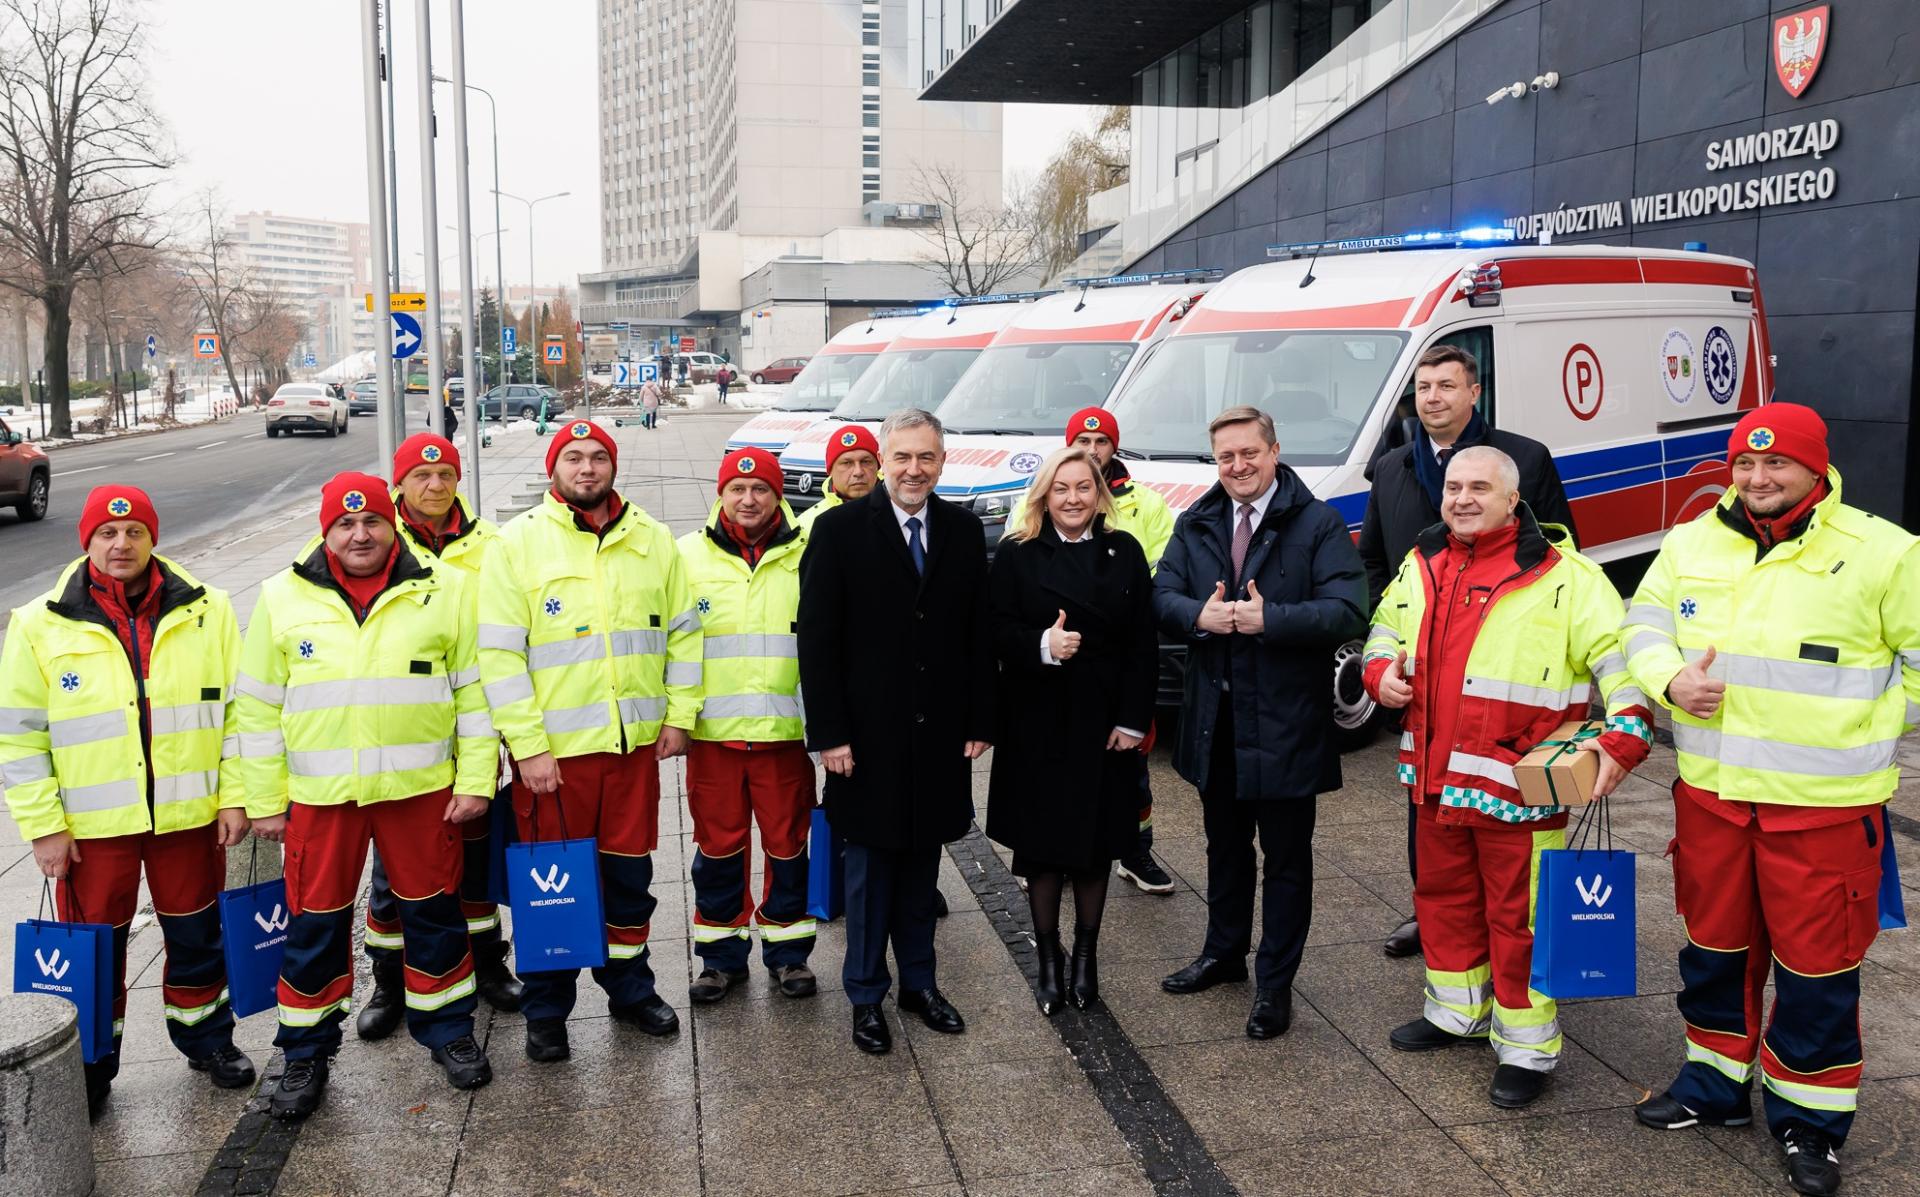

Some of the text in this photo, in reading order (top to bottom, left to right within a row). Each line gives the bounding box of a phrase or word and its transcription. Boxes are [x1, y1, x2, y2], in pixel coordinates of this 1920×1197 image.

[1706, 119, 1839, 171] SAMORZĄD
[1631, 167, 1836, 225] WIELKOPOLSKIEGO
[1341, 237, 1400, 249] AMBULANS
[1576, 361, 1592, 404] P
[530, 897, 575, 907] WIELKOPOLSKA
[1571, 913, 1615, 921] WIELKOPOLSKA
[254, 934, 288, 951] WIELKOPO
[31, 982, 73, 993] WIELKOPOLSKA
